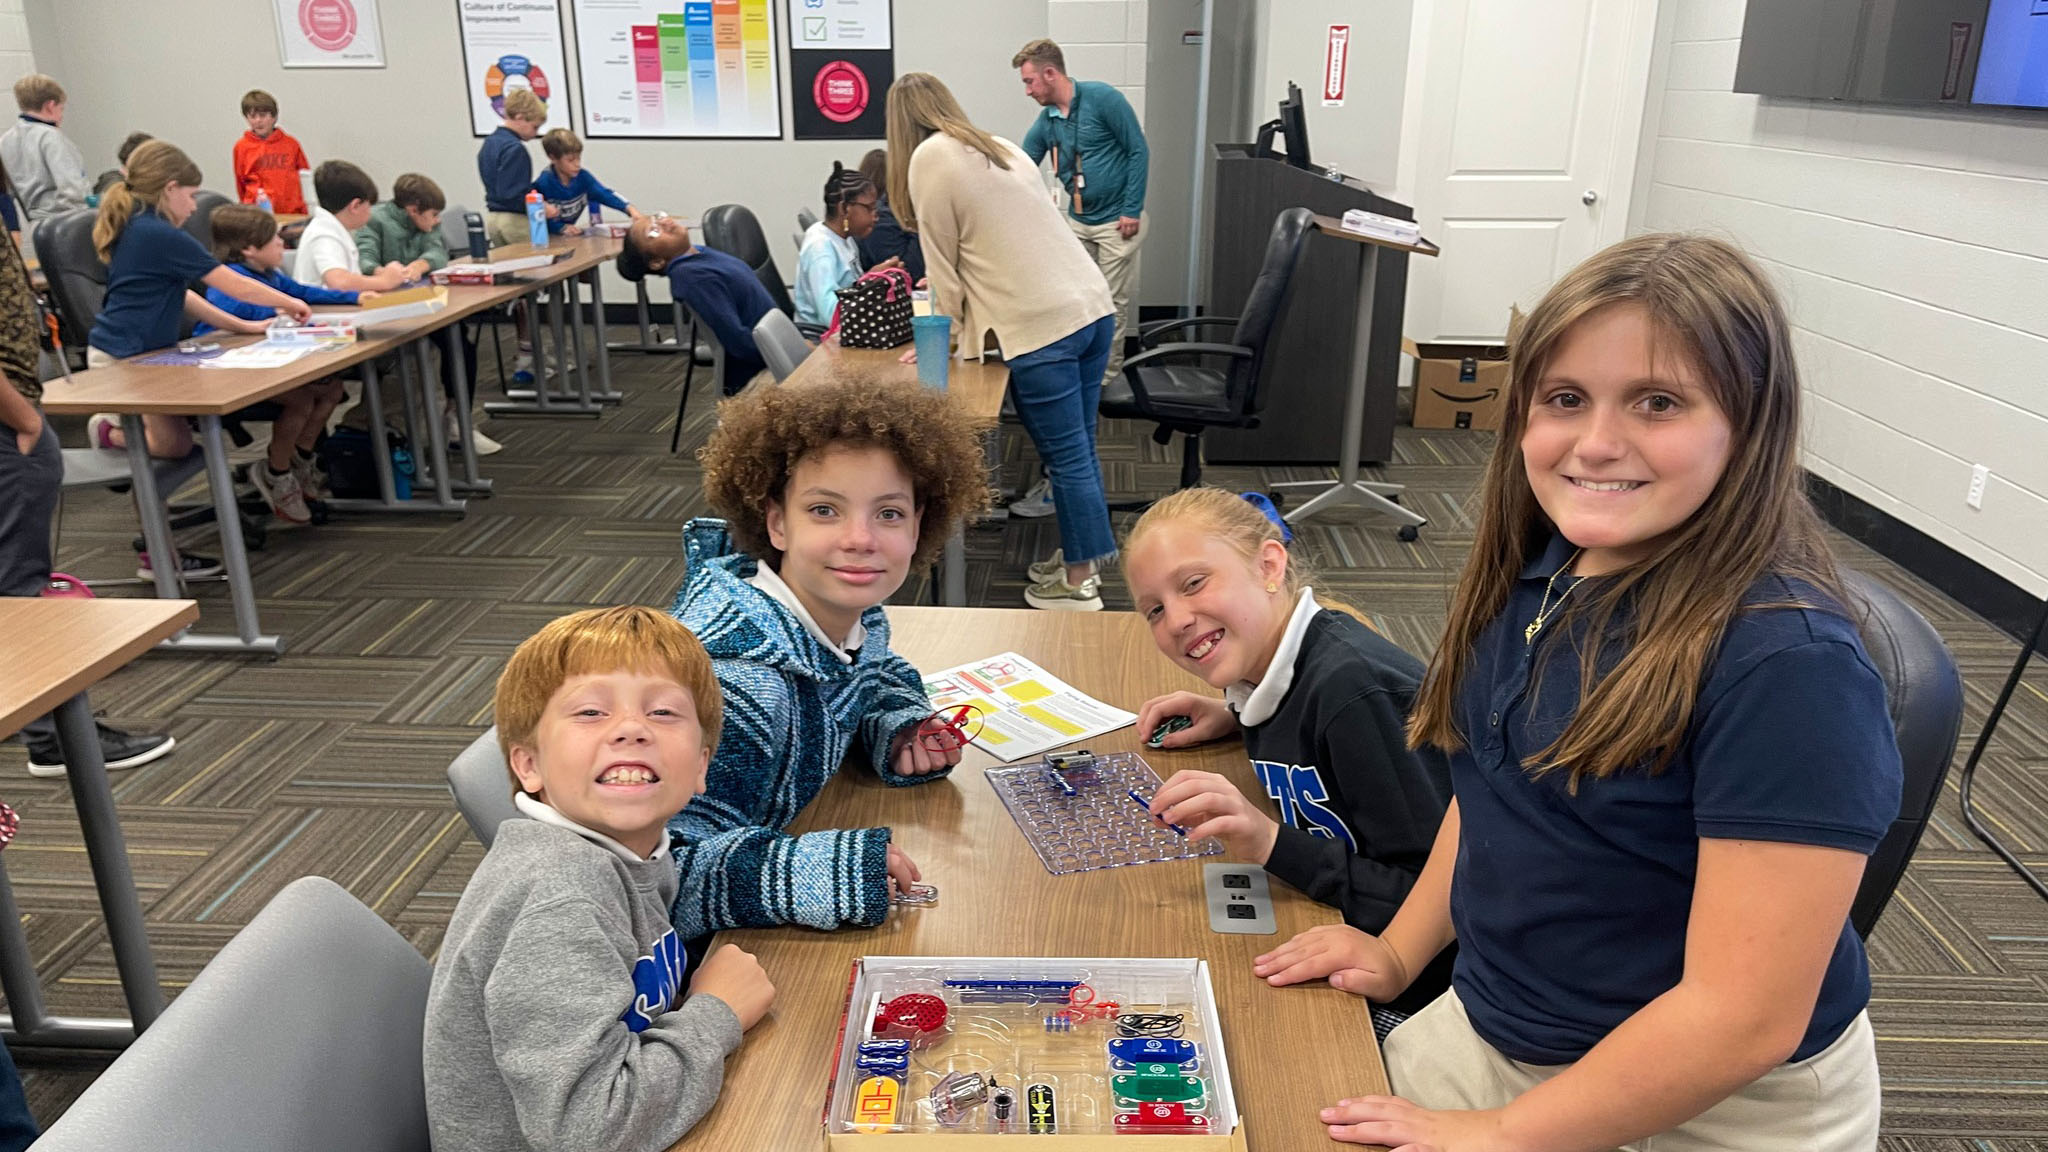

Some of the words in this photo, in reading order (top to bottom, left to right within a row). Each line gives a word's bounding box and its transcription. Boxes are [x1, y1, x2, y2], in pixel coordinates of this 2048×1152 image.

[464, 3, 494, 11] Culture
[497, 3, 504, 11] of
[507, 3, 555, 11] Continuous
[465, 15, 521, 24] Improvement
[828, 80, 854, 88] THINK
[828, 87, 855, 95] THREE
